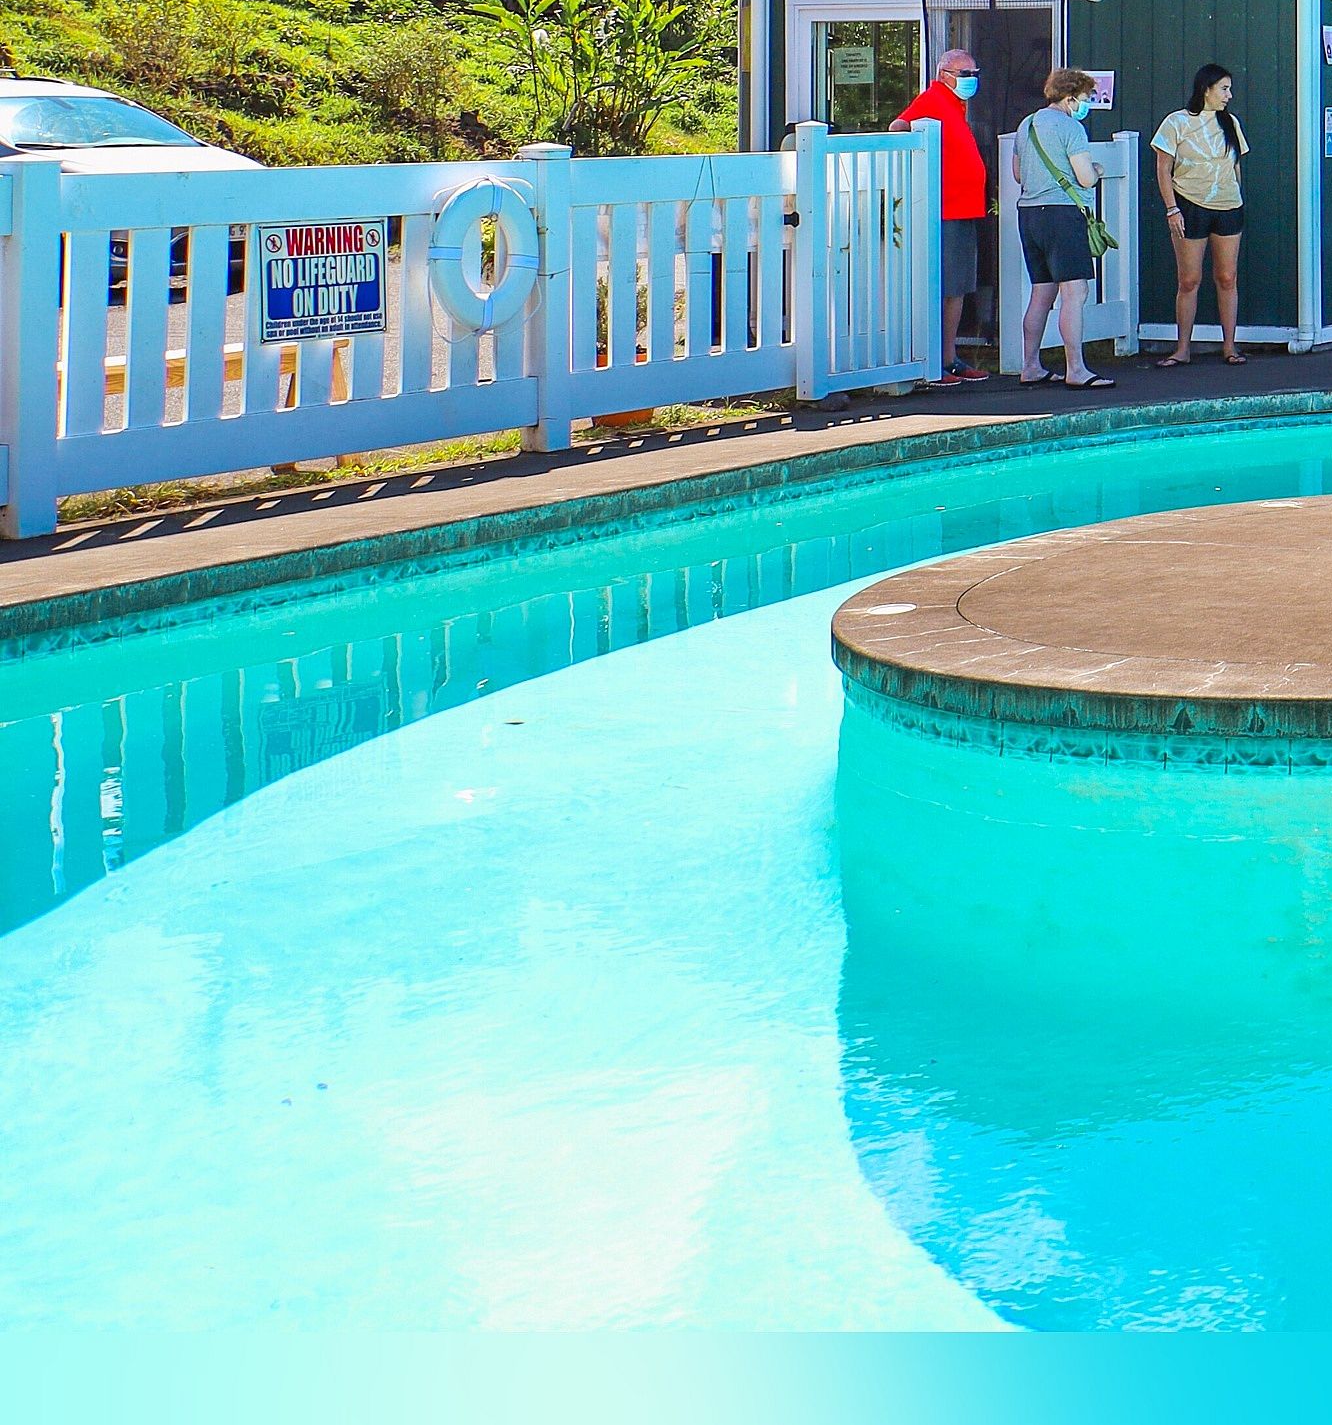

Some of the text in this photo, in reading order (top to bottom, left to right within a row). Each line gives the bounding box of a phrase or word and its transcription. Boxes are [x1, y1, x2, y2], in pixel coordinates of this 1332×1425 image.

[285, 225, 364, 256] WARNING
[271, 254, 376, 289] NO LIFEGUARD
[293, 284, 358, 317] ON DUTY
[292, 319, 308, 327] under
